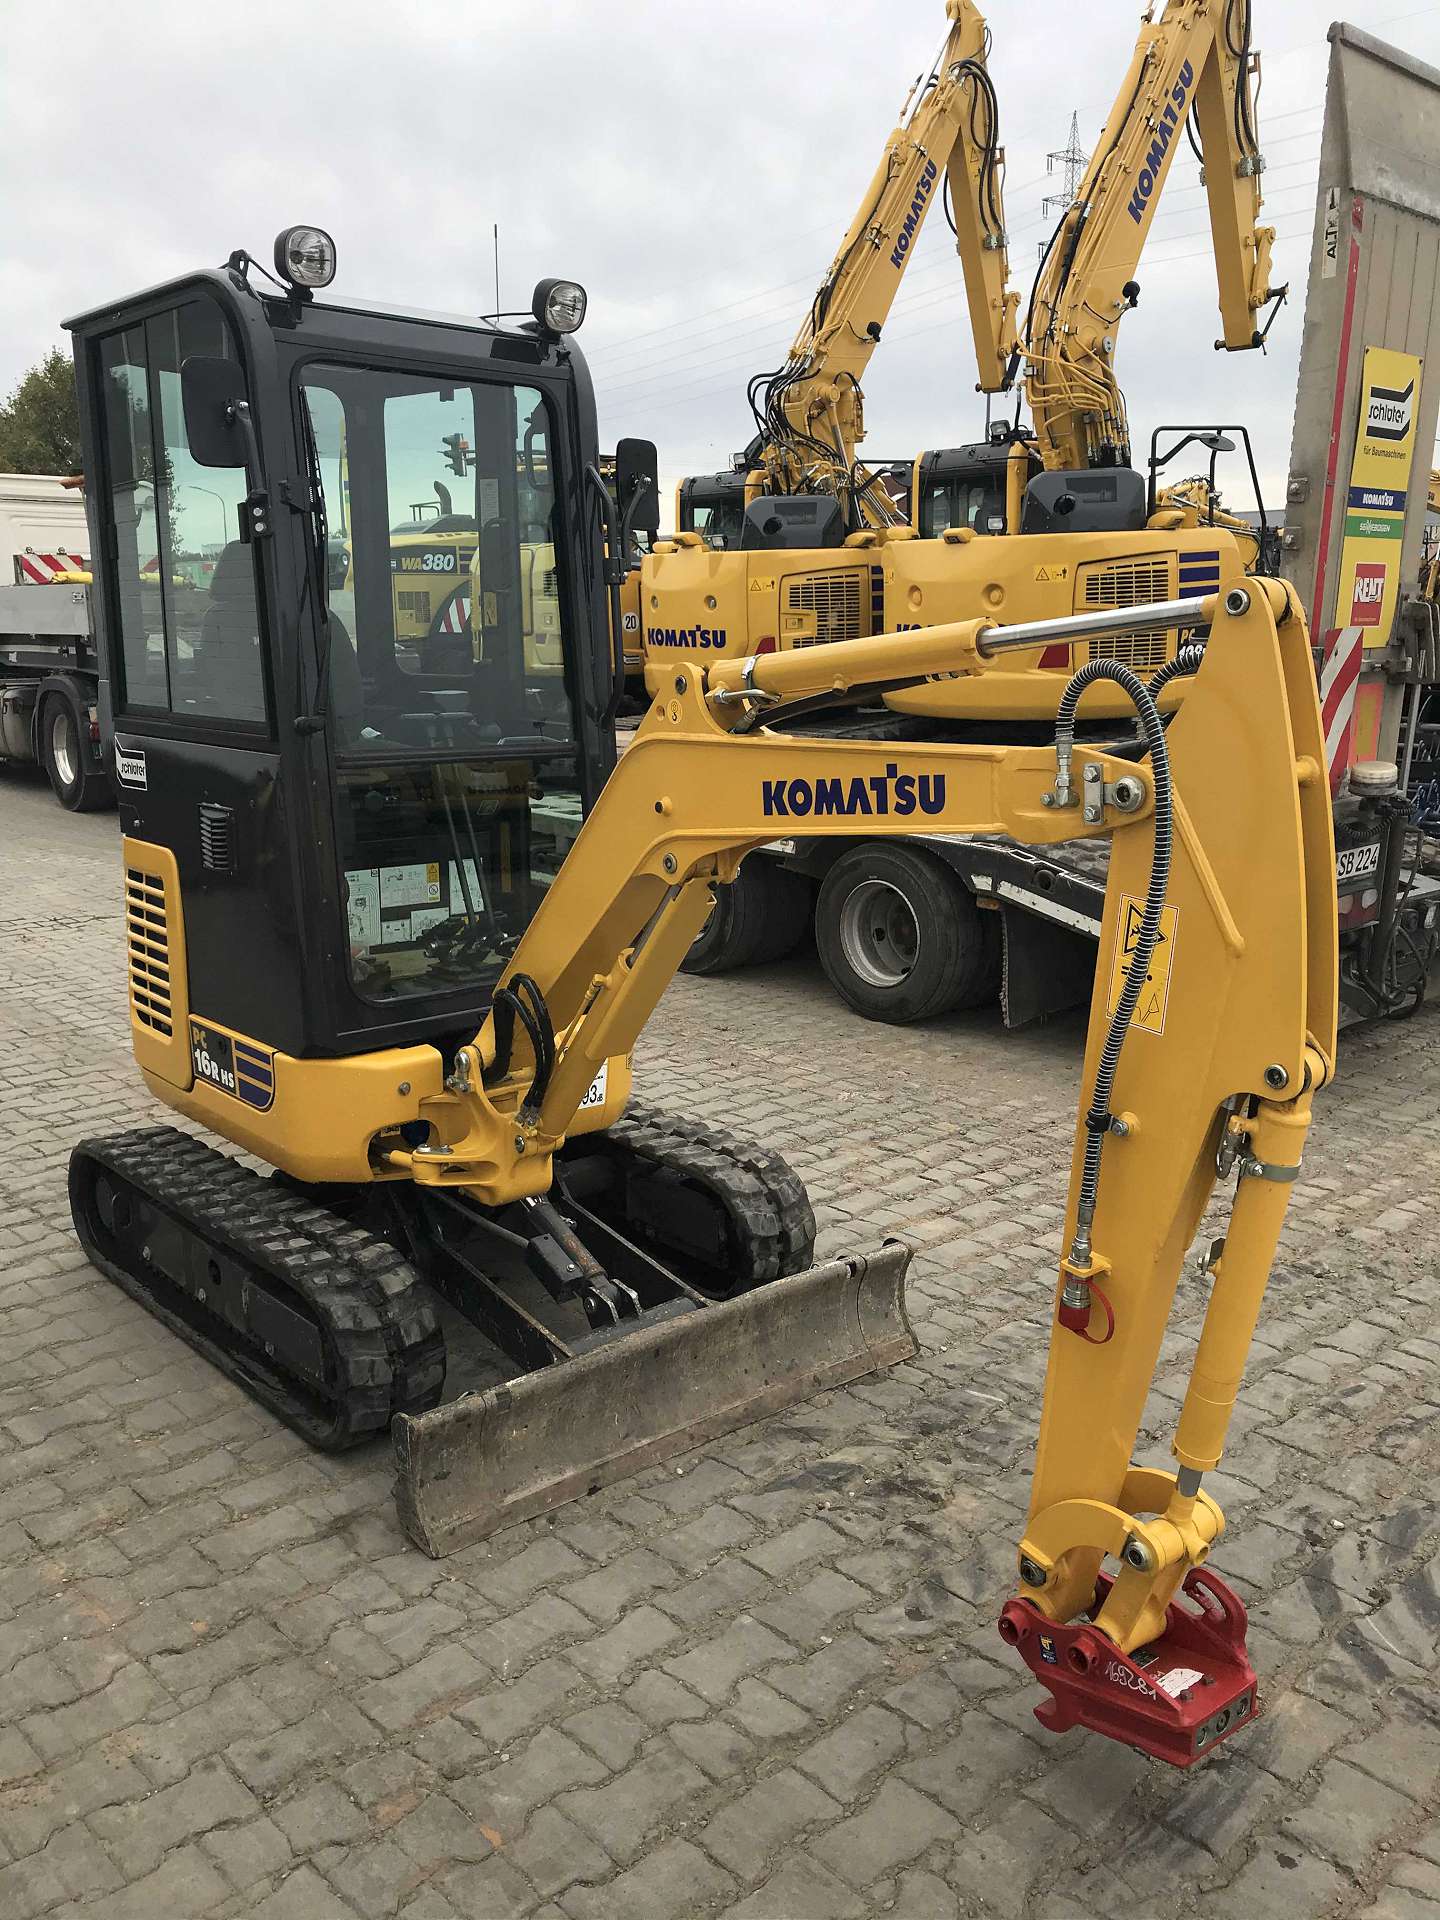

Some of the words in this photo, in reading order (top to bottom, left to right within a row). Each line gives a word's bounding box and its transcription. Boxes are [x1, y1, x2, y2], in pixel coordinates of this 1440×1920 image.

[1127, 57, 1194, 225] KOMATSU
[890, 158, 937, 269] KOMATSU
[1362, 491, 1394, 506] KOMATSU
[401, 553, 455, 571] WA380
[625, 615, 637, 630] 20
[647, 624, 727, 649] KOMATSU
[762, 763, 947, 817] KOMATSU
[1338, 851, 1355, 877] SB
[1354, 846, 1379, 872] 224
[192, 1026, 208, 1050] PC
[220, 1068, 235, 1089] HS
